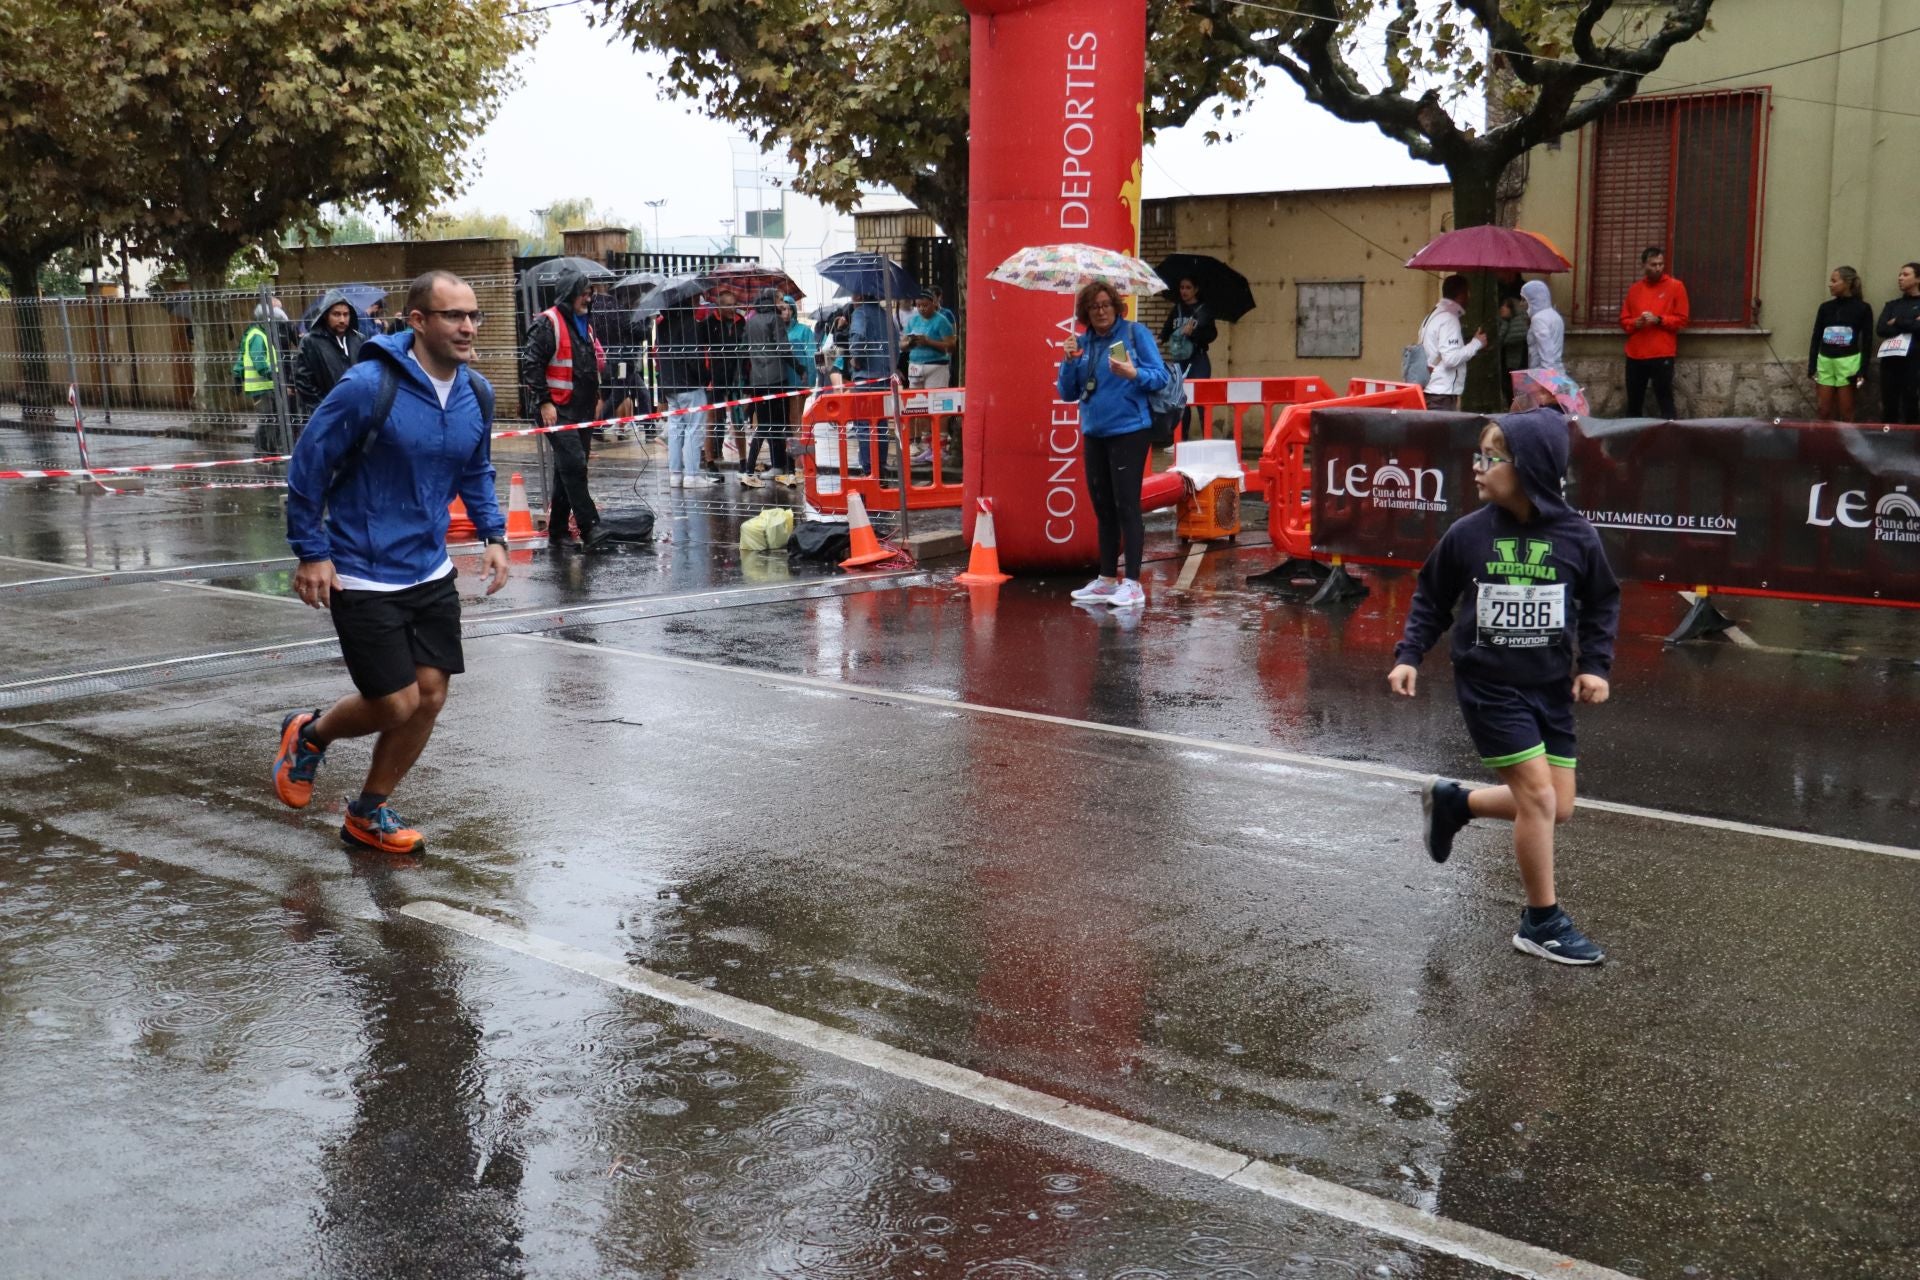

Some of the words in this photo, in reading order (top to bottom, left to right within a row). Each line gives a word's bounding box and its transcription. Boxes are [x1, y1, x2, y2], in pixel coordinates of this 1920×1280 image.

[1060, 32, 1097, 229] DEPORTES
[1372, 487, 1395, 498] Cuna
[1397, 488, 1410, 499] del
[1373, 498, 1447, 512] Parlamentarismo
[1577, 510, 1672, 526] YUNTAMIENTO
[1677, 515, 1695, 527] DE
[1699, 515, 1737, 529] LEÓN
[1875, 516, 1904, 529] Cuna
[1486, 562, 1557, 580] VEDRUNA
[1491, 601, 1551, 627] 2986
[1508, 636, 1549, 645] HYUNDAI
